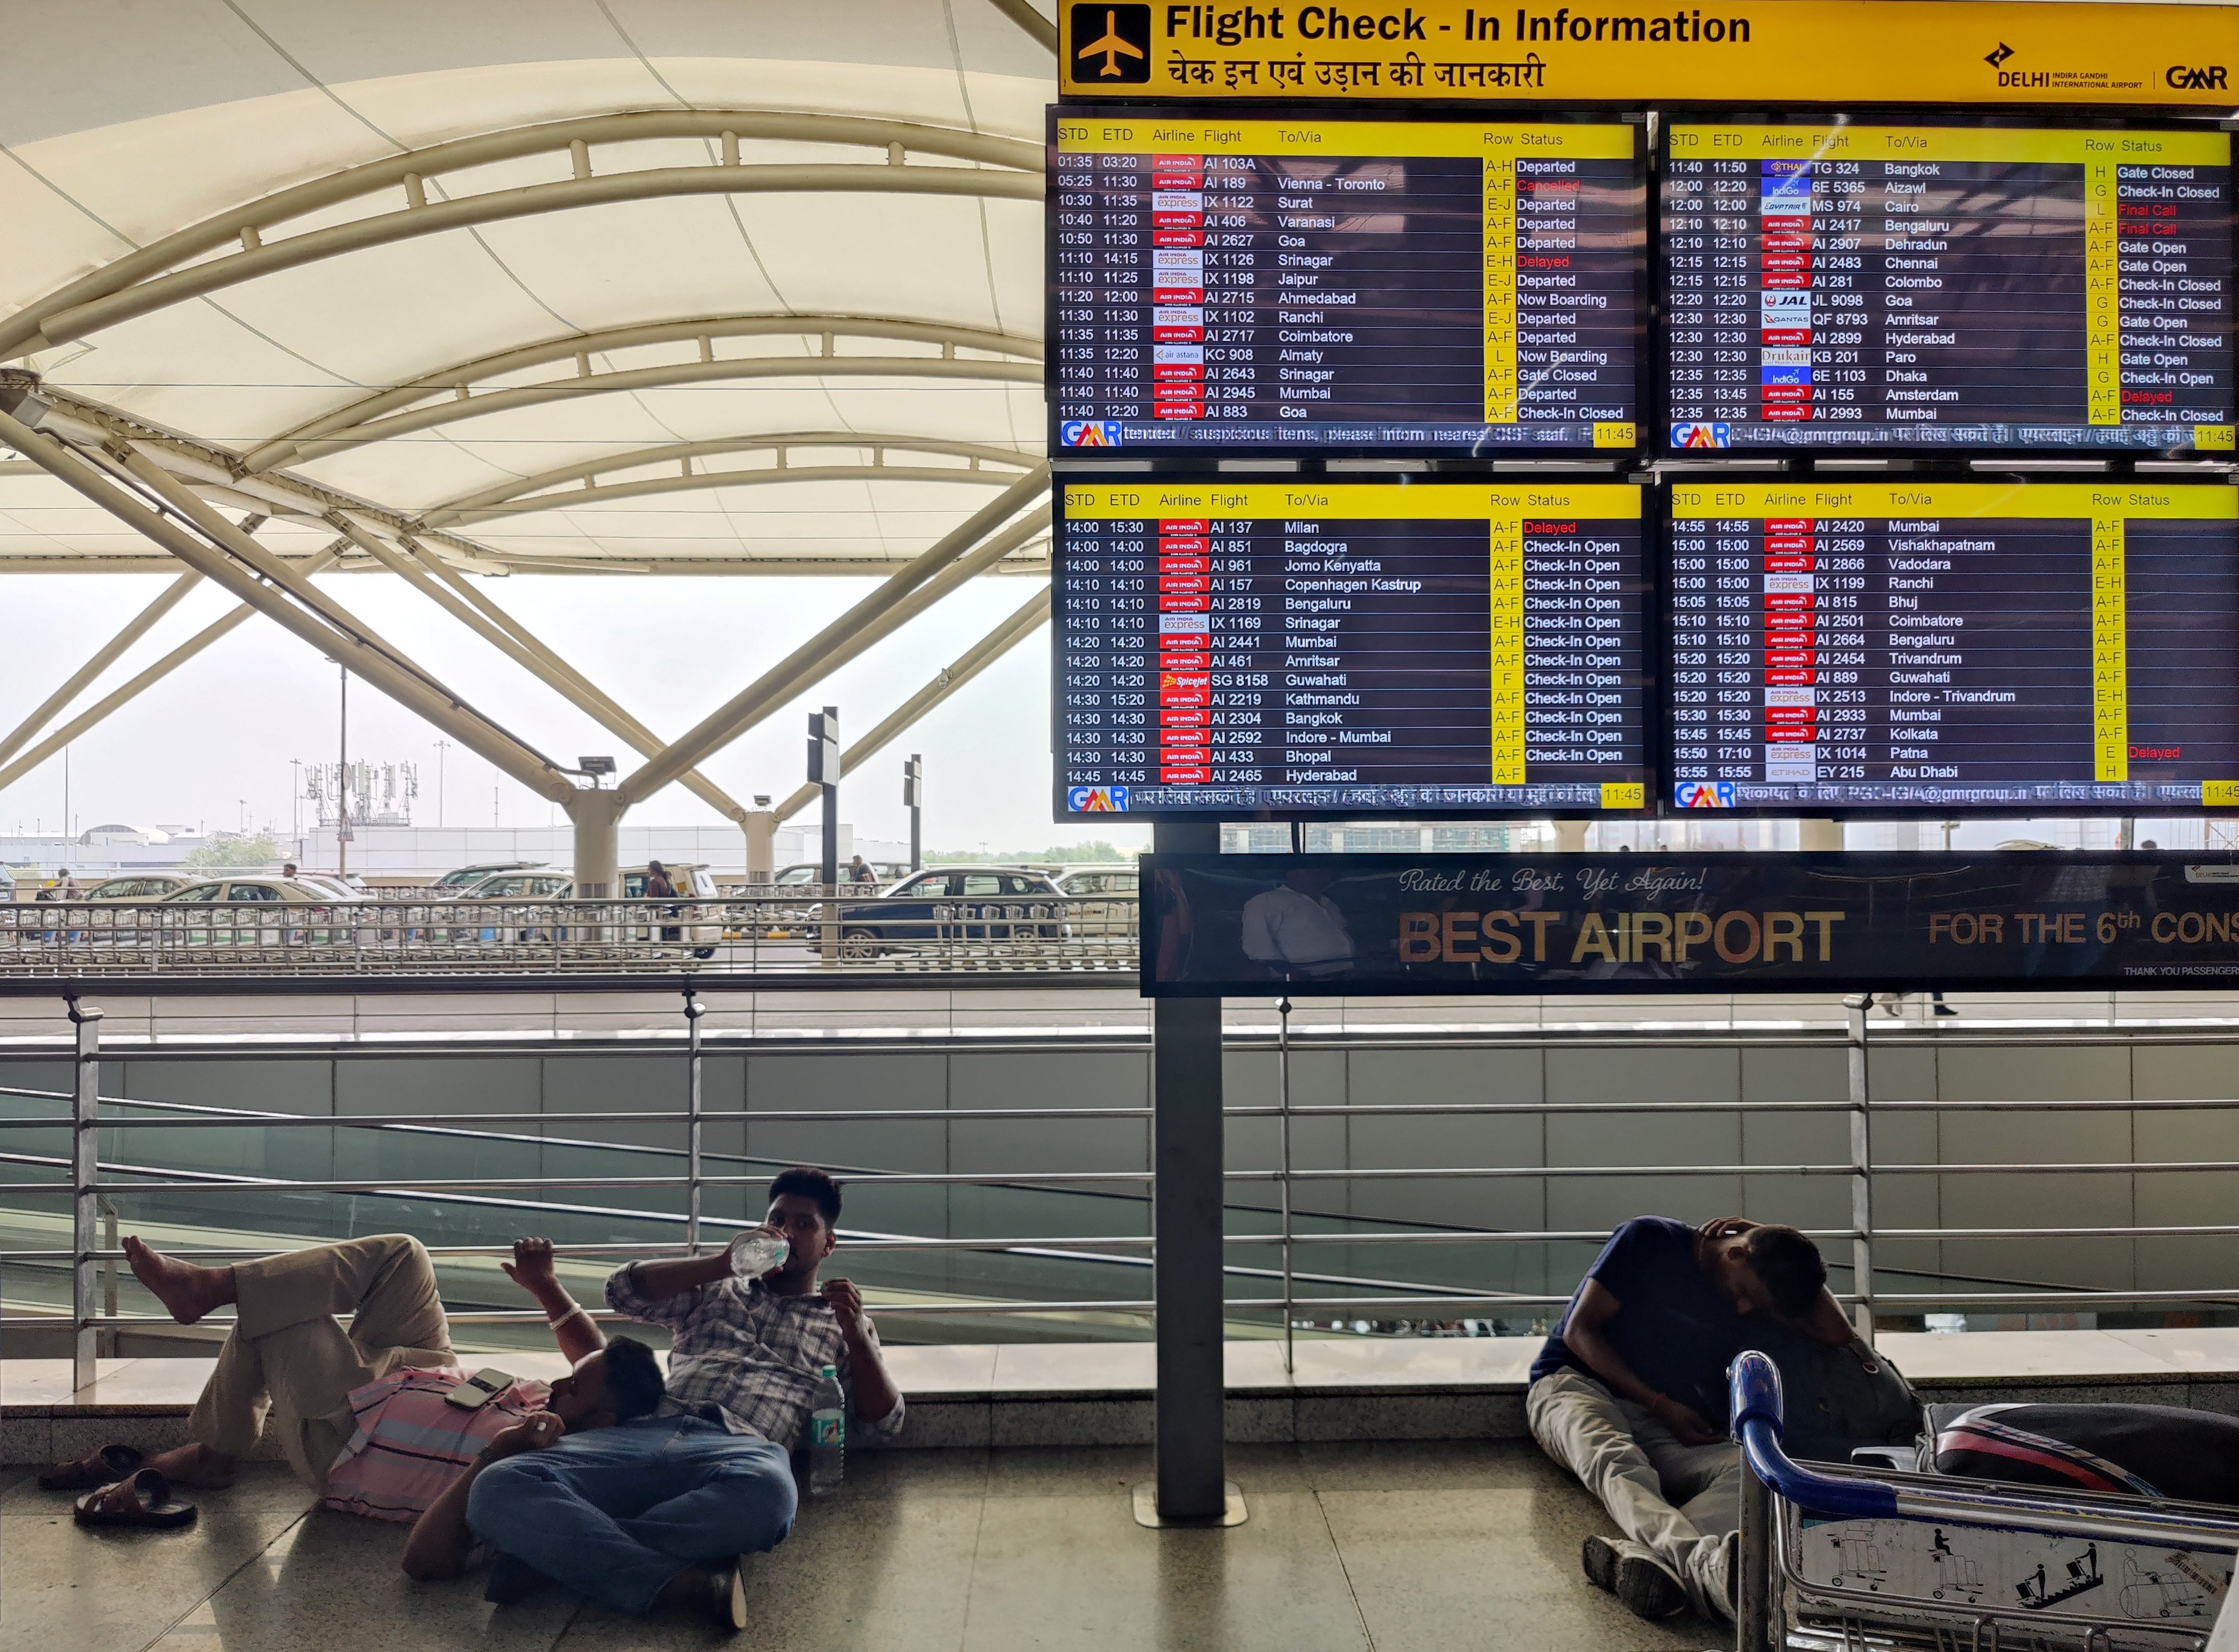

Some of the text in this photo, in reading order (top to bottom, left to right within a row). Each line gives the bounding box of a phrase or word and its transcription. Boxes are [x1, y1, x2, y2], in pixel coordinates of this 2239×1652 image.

[1167, 5, 1283, 46] Flight
[1298, 7, 1426, 40] Check
[1466, 9, 1499, 40] In
[1517, 9, 1749, 42] Information
[1168, 50, 1546, 92] चेक इन एवं उड़ान की जानकारी
[1999, 72, 2049, 87] DELHI
[2166, 66, 2227, 90] GMR
[1058, 128, 1562, 145] STD ETD Airline Flight To/Via Row Status
[1670, 134, 2162, 152] STD ETD Airline Flight To/Via Row Status
[1058, 156, 1092, 167] 01:35
[1103, 157, 1137, 167] 03:20
[1204, 158, 1217, 169] AI
[1222, 158, 1256, 171] 103A
[1486, 160, 1512, 171] A-H
[1517, 161, 1575, 175] Departed
[1059, 195, 1092, 205] 10:30
[1104, 195, 1137, 206] 11:35
[1205, 196, 1218, 207] IX
[1223, 197, 1253, 208] 1122
[1278, 197, 1313, 208] Surat
[1488, 198, 1510, 210] E-J
[1517, 198, 1575, 213] Departed
[1157, 198, 1198, 208] express
[1670, 294, 2221, 309] 12:20 12:20 JAL JL 9098 Goa G Check-In Closed
[1060, 348, 1094, 359] 11:35
[1105, 348, 1138, 359] 12:20
[1205, 349, 1225, 360] KC
[1229, 349, 1253, 360] 908
[1279, 349, 1323, 364] Almaty
[1497, 350, 1504, 362] L
[1518, 351, 1547, 362] Now
[1550, 351, 1607, 367] Boarding
[1670, 350, 2188, 368] 12:30 12:30 Drukair KB 201 Paro H Gate Open
[1062, 422, 1122, 446] GMR
[1598, 428, 1633, 439] 11:45
[1672, 424, 1729, 447] GMR
[2198, 431, 2232, 443] 11:45
[1065, 494, 1570, 508] STD ETD Airline Flight To/Via Row Status
[1672, 493, 2170, 508] STD ETD Airline Flight To/Via Row Status
[1066, 522, 1098, 533] 14:00
[1111, 522, 1143, 533] 15:30
[1210, 522, 1223, 533] AI
[1229, 522, 1252, 533] 137
[1285, 522, 1319, 533] Milan
[1494, 522, 1518, 533] A-F
[1524, 521, 1576, 536] Delayed
[1673, 539, 1705, 551] 15:00
[1716, 539, 1749, 551] 15:00
[1815, 539, 1828, 551] AI
[1832, 539, 1864, 551] 2569
[1888, 539, 1995, 553] Vishakhapatnam
[2096, 539, 2119, 551] A-F
[1067, 675, 1101, 686] 14:20
[1111, 675, 1144, 686] 14:20
[1211, 675, 1232, 686] SG
[1236, 675, 1268, 686] 8158
[1286, 674, 1346, 685] Guwahati
[1504, 673, 1511, 685] F
[1525, 673, 1582, 685] Check-In
[1586, 673, 1621, 687] Open
[1674, 766, 1707, 778] 15:55
[1718, 766, 1751, 778] 15:55
[1818, 766, 1837, 778] EY
[1840, 766, 1864, 778] 215
[1890, 766, 1916, 778] Abu
[1921, 766, 1957, 777] Dhabi
[2106, 766, 2115, 777] H
[1068, 786, 1128, 812] GMR
[1605, 788, 1641, 800] 11:45
[1675, 782, 1735, 808] GMR
[2206, 786, 2239, 797] 11:45
[1399, 867, 1706, 901] Rated the Best, Yet Again!
[1929, 913, 2004, 944] FOR
[2013, 912, 2086, 943] THE
[2097, 911, 2141, 944] 6th
[1399, 910, 1845, 963] BEST AIRPORT
[2124, 967, 2157, 976] THANK
[2159, 967, 2179, 976] YOU
